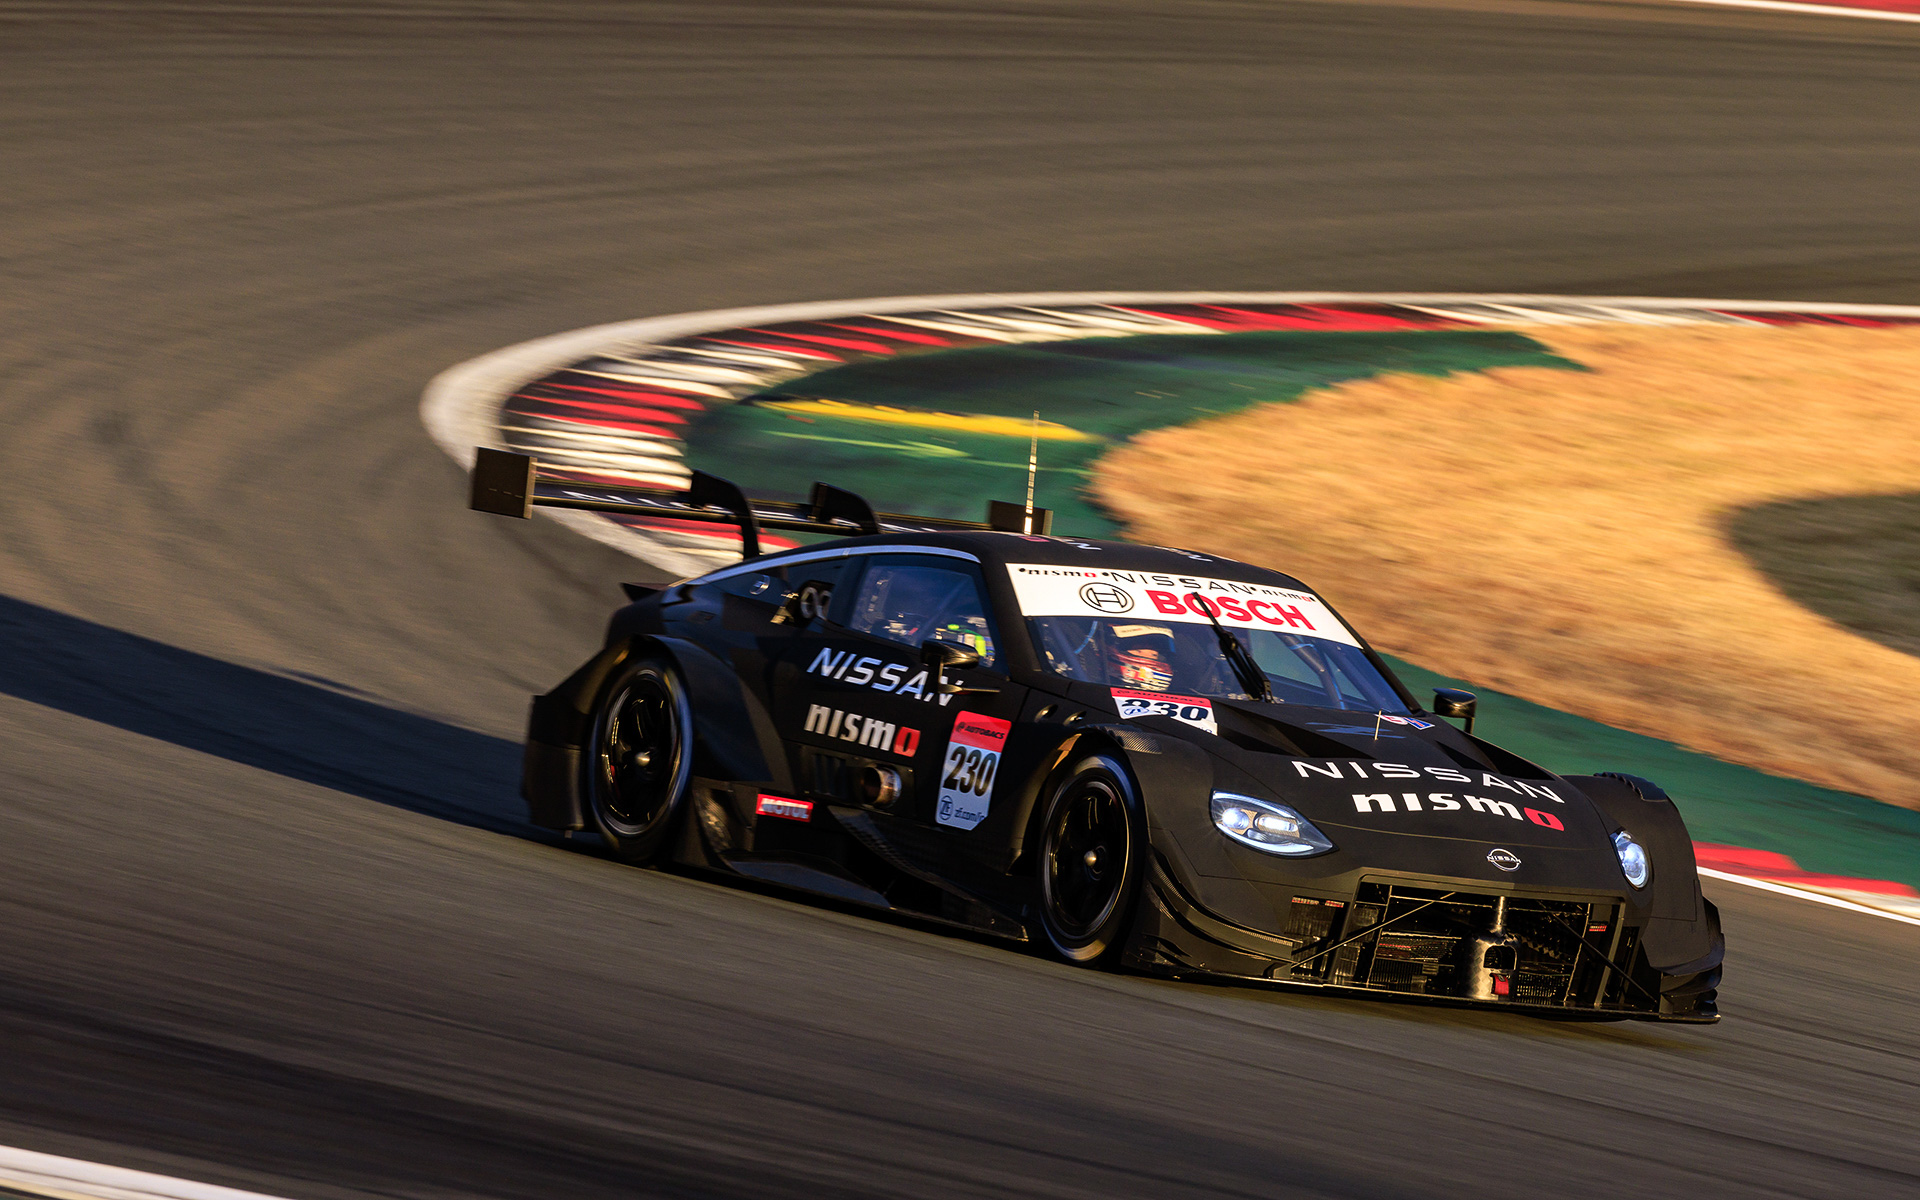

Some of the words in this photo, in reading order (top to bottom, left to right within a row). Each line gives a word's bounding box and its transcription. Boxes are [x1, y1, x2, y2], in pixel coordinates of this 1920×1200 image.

[1028, 568, 1097, 578] nismo
[1111, 572, 1253, 595] NISSAN
[1262, 589, 1312, 603] nismo
[1145, 589, 1317, 631] BOSCH
[803, 703, 921, 758] nismo
[964, 724, 1006, 740] AUTOBACS
[942, 746, 997, 797] 230
[1291, 760, 1566, 804] NISSAN
[758, 798, 810, 819] MOTUL
[1352, 792, 1565, 831] nismo
[1486, 855, 1522, 864] NISSAN
